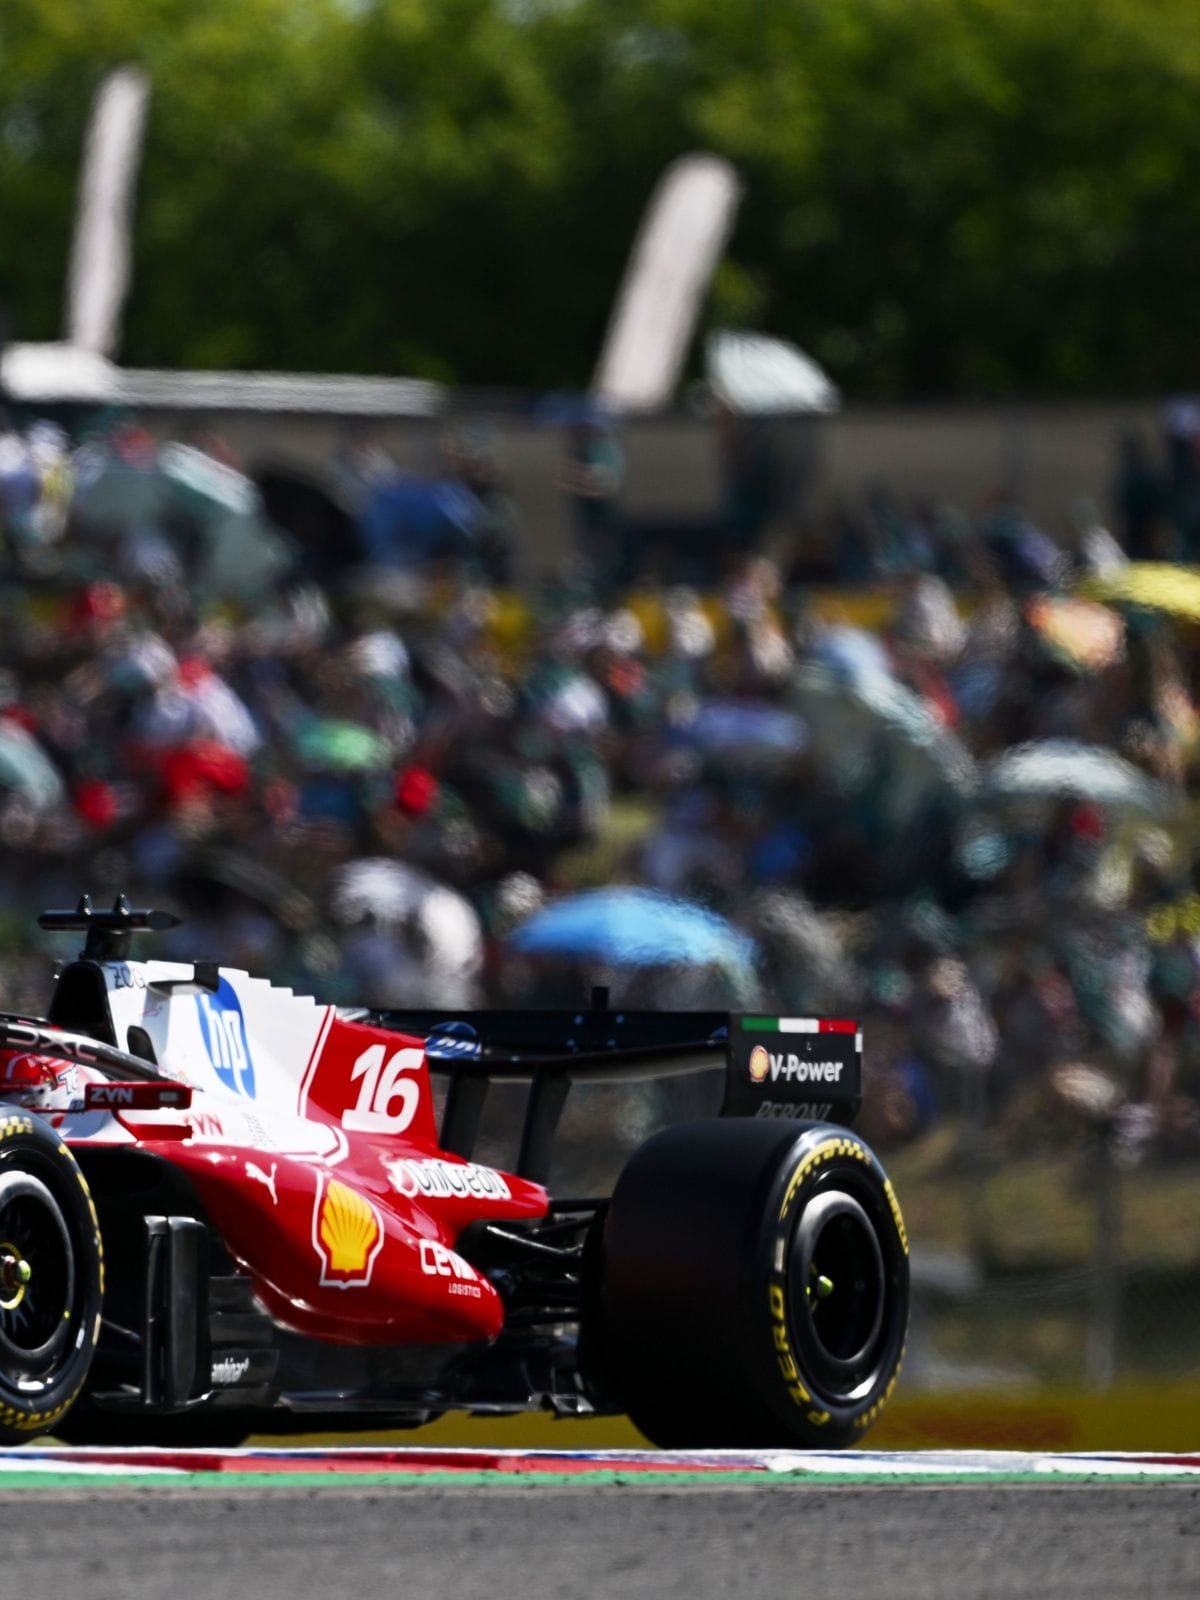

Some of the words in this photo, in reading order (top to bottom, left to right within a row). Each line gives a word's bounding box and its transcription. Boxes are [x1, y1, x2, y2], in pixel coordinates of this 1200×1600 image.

[201, 994, 248, 1098] hp
[769, 1053, 843, 1082] V-Power
[90, 1087, 134, 1104] ZYN
[342, 1044, 424, 1134] 16
[184, 1113, 224, 1137] YN
[448, 1282, 482, 1299] LOGISTICS
[769, 1285, 811, 1406] ZERO
